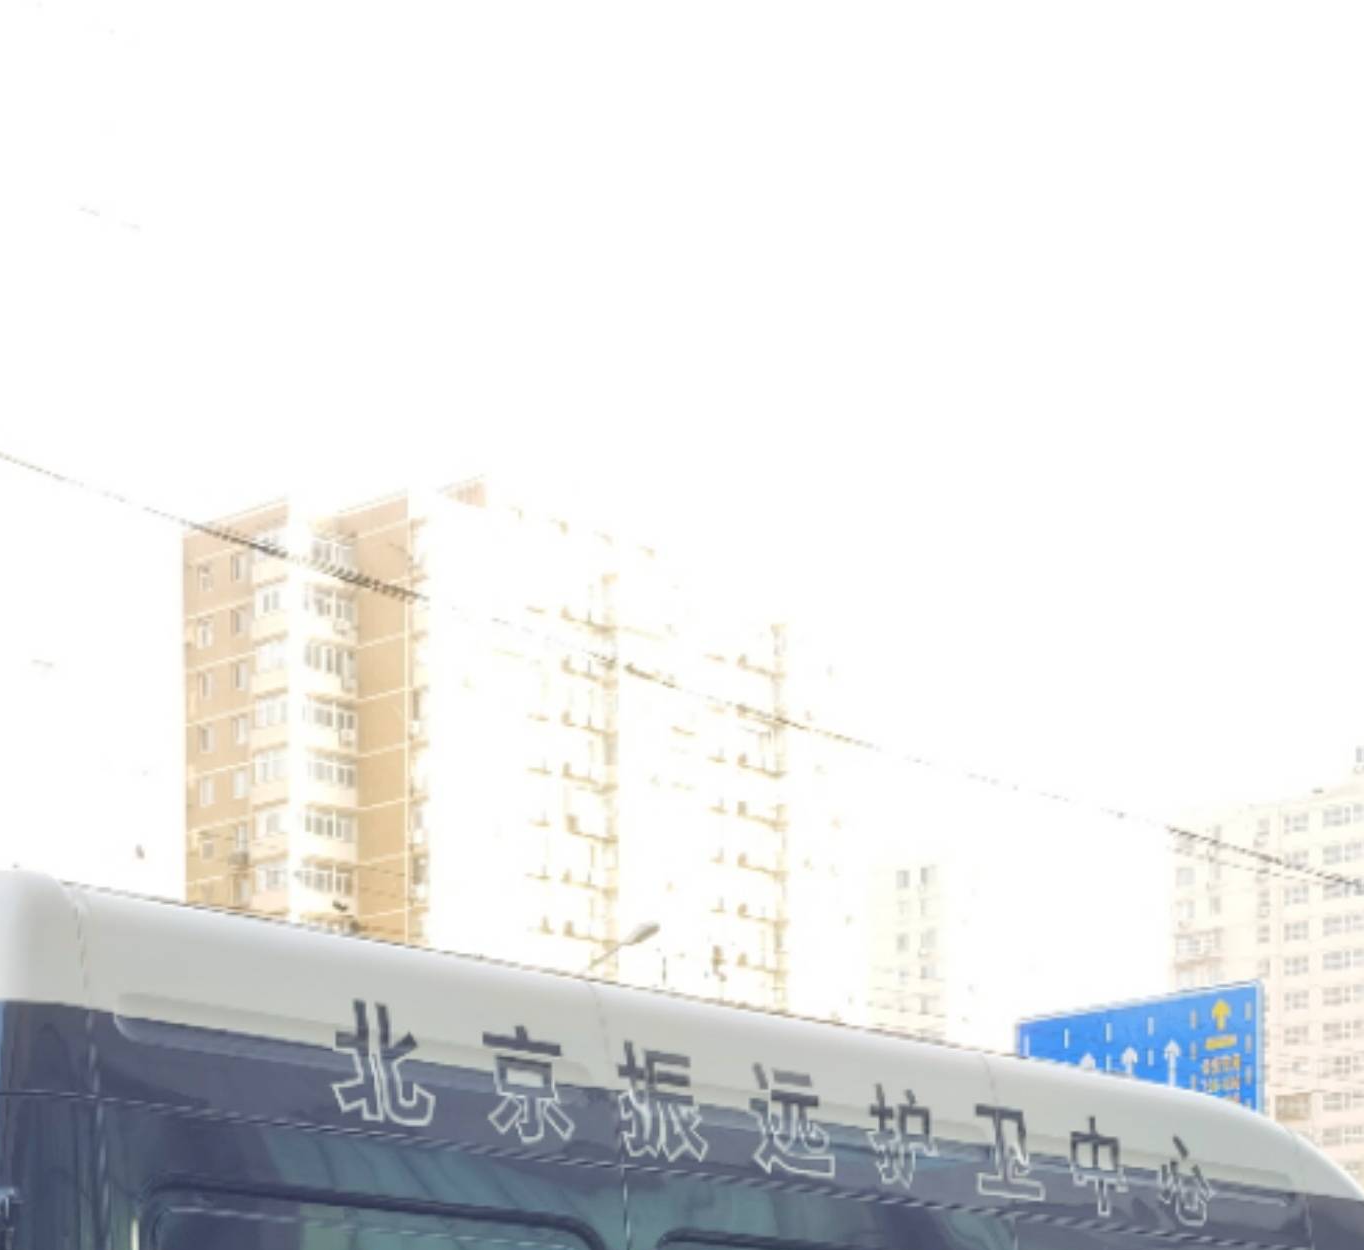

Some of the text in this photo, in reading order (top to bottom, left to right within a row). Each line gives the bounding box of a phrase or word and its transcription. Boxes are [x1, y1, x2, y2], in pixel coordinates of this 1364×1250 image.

[332, 999, 1215, 1227] 北京振远护卫中心
